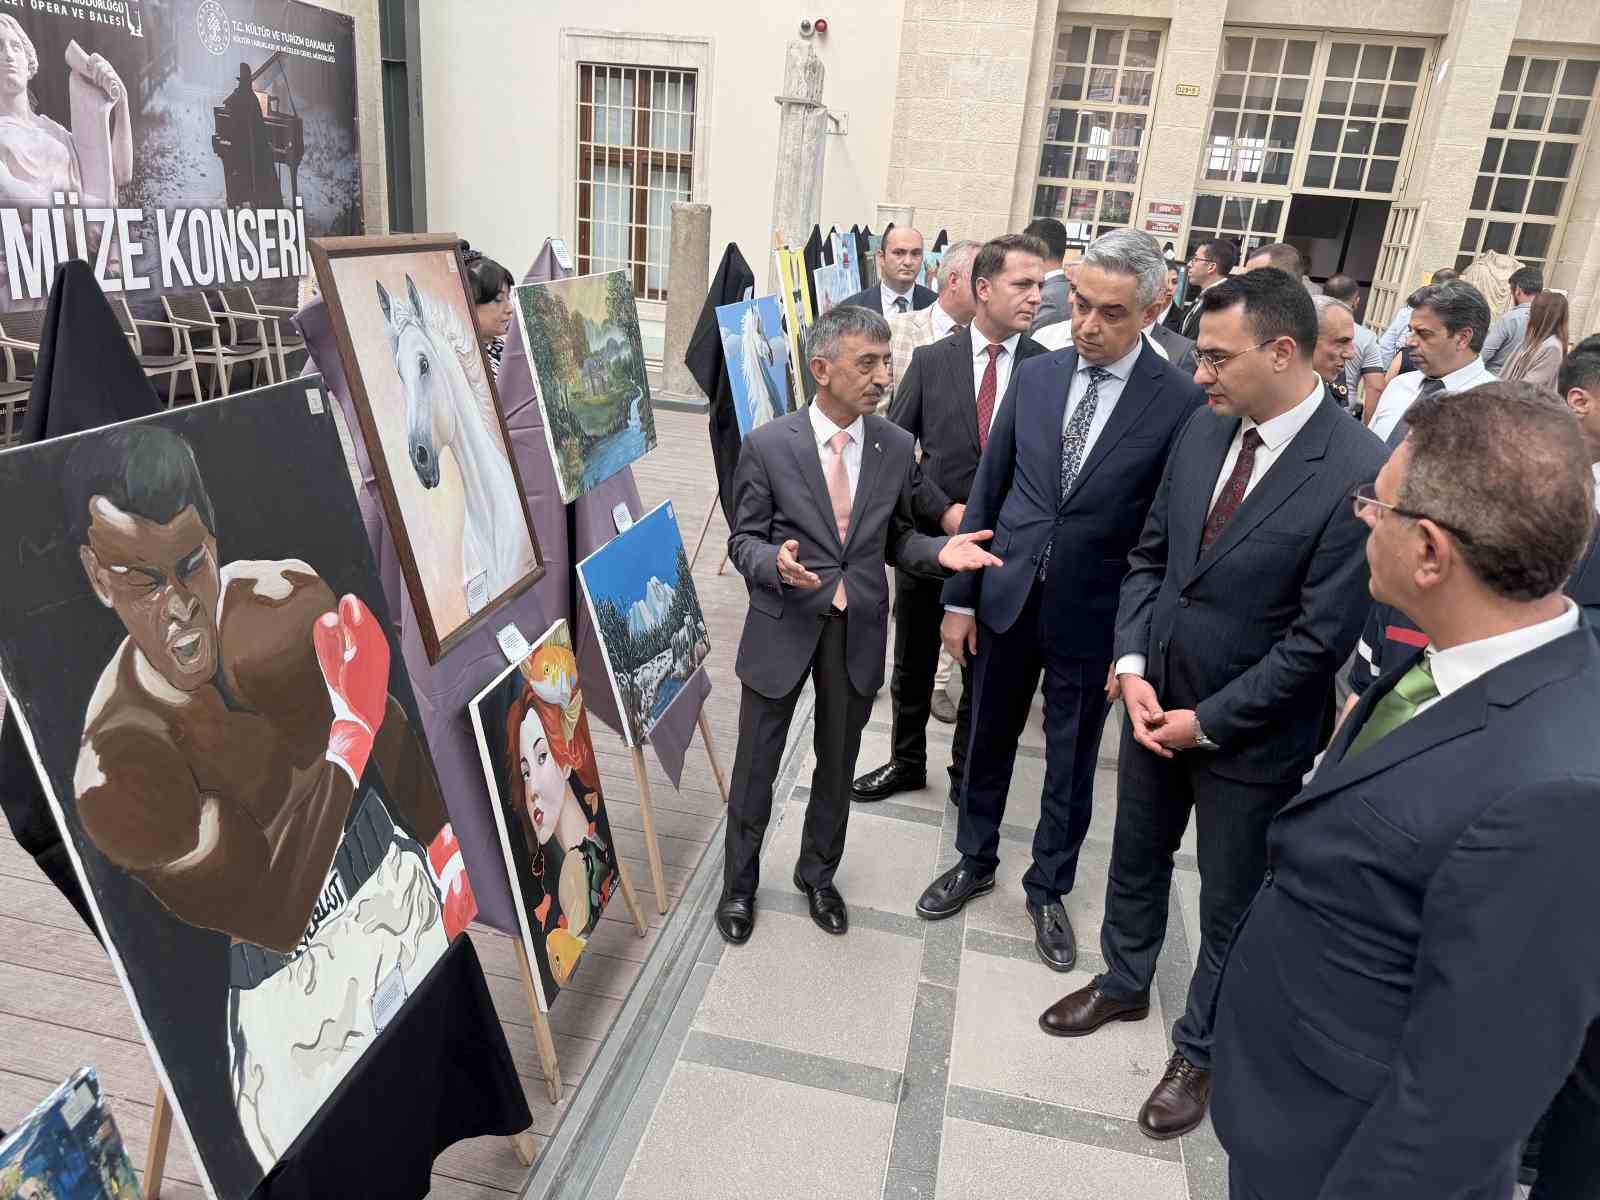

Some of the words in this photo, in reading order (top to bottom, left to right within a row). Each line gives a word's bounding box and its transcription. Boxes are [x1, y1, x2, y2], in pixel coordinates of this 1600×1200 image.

[31, 0, 68, 15] OPERA
[71, 7, 85, 19] VE
[245, 22, 271, 39] KÜLTÜR
[0, 191, 150, 300] MÜZE
[156, 196, 308, 288] KONSERİ
[296, 871, 345, 957] VERLAST
